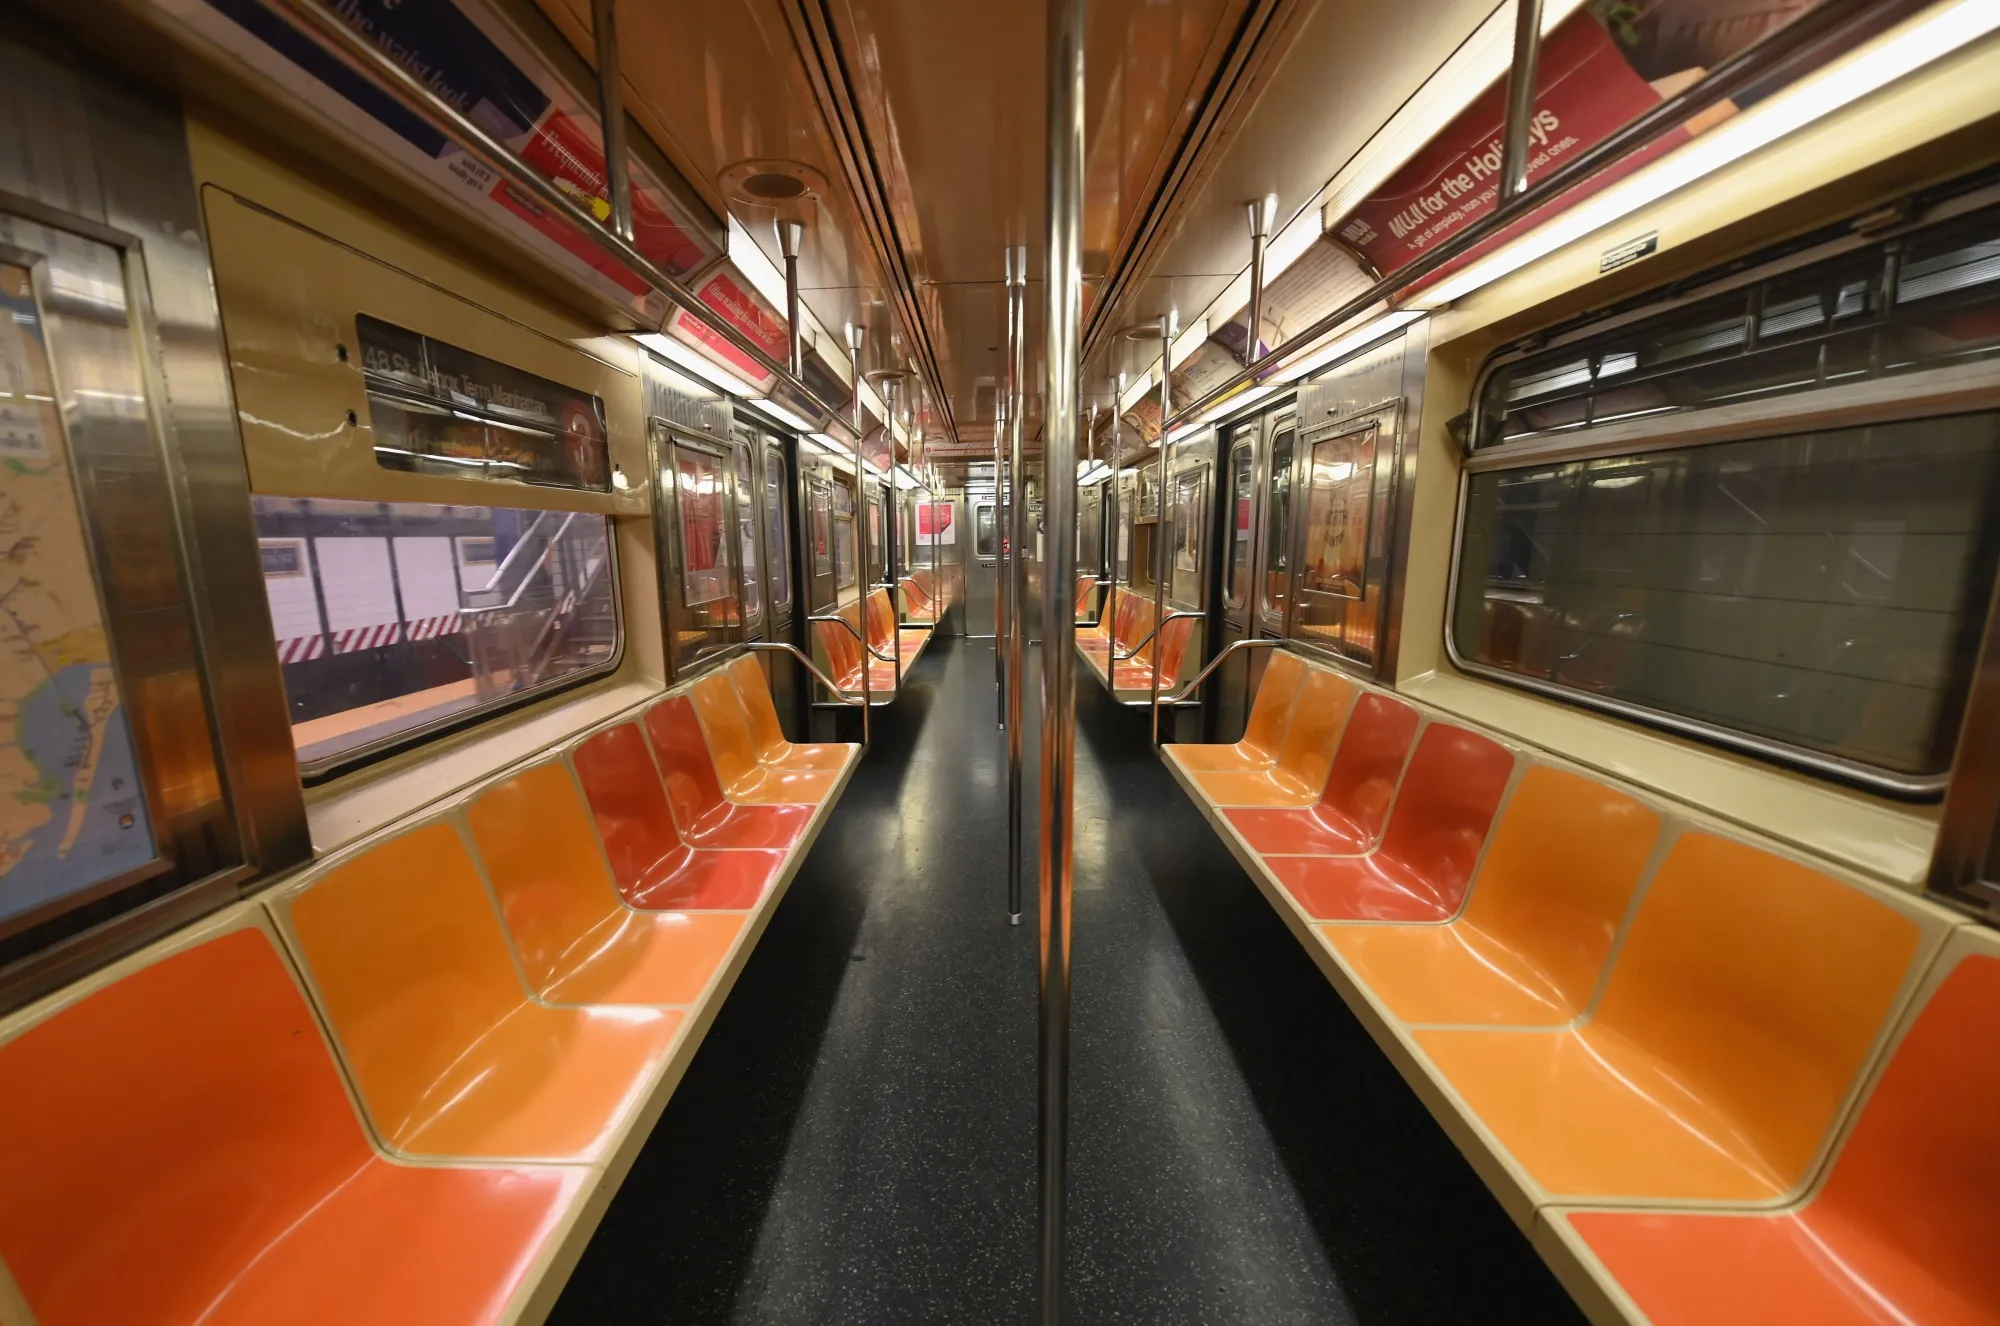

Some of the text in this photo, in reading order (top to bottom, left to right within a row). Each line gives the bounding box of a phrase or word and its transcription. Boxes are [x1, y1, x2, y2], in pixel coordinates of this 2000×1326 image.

[1388, 204, 1428, 239] MUJI
[1420, 190, 1448, 214] for
[1442, 173, 1474, 199] the
[1465, 109, 1559, 181] Holiys
[1460, 199, 1482, 213] from
[1547, 136, 1579, 156] ones.
[1342, 218, 1373, 242] MUJI
[708, 282, 723, 301] Often
[722, 296, 743, 321] waiting
[572, 413, 595, 471] 3
